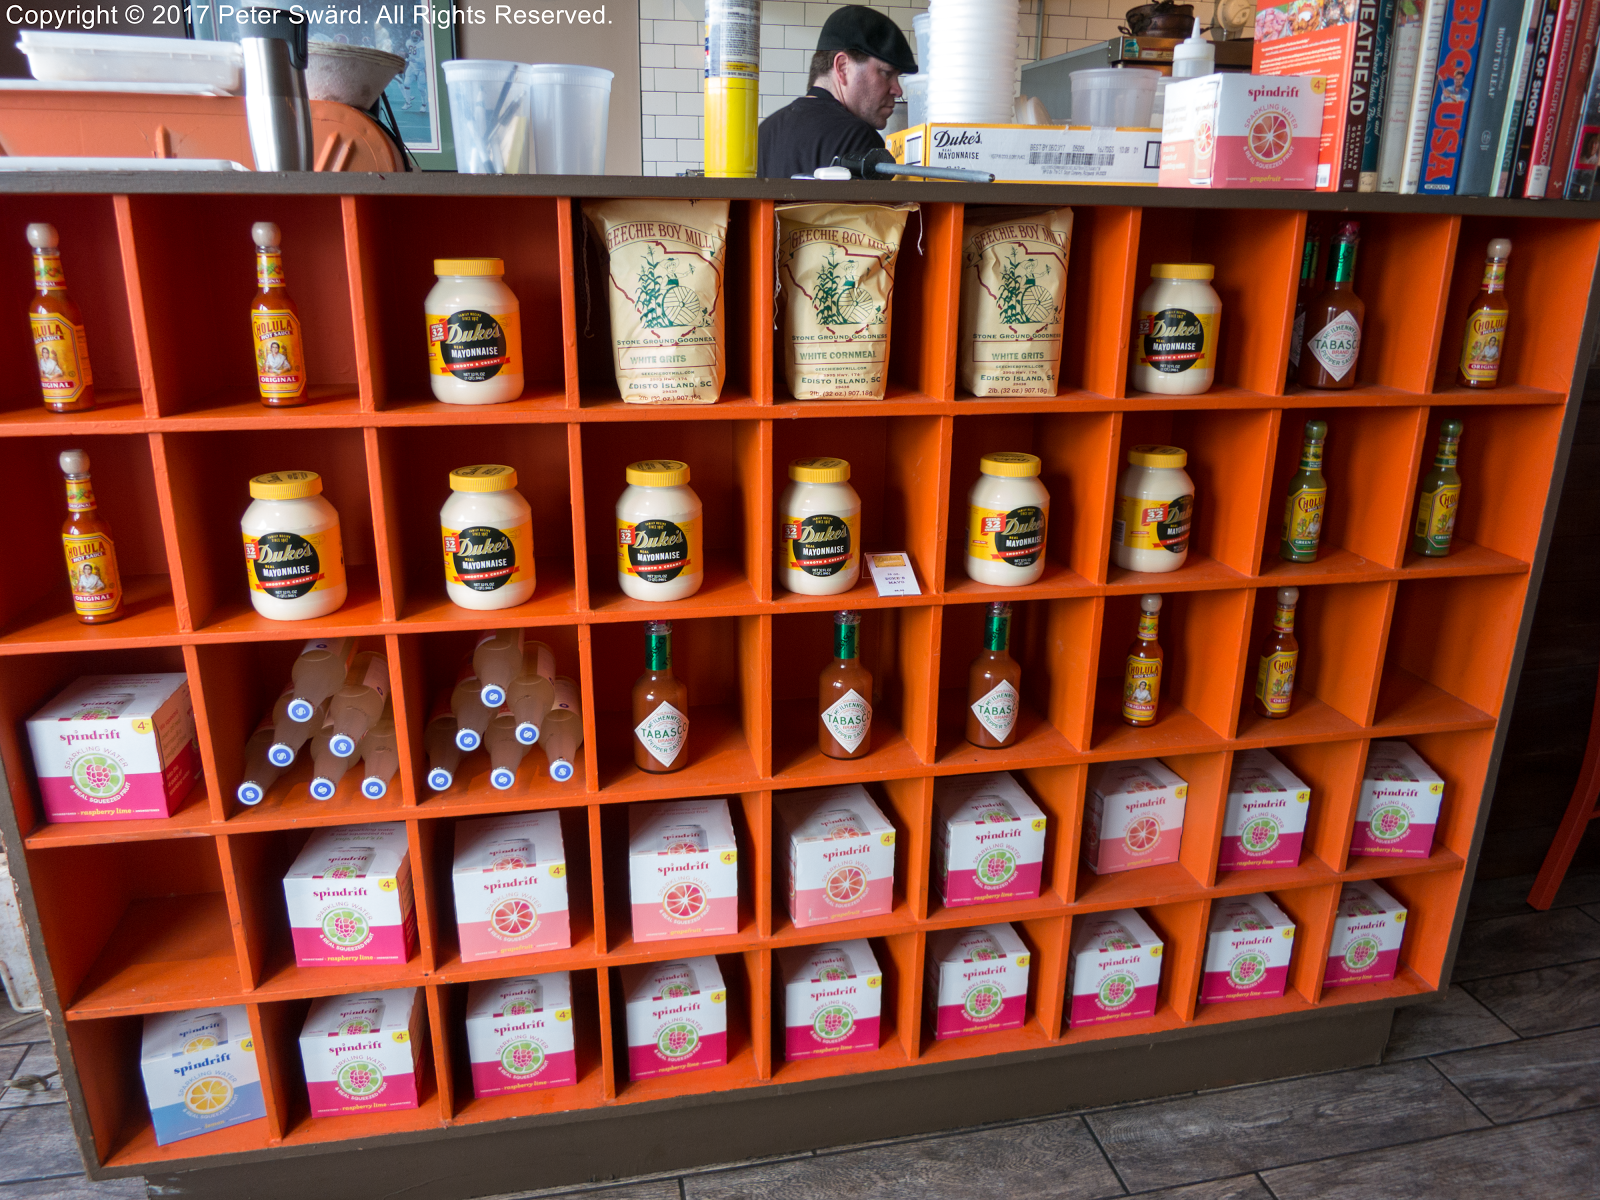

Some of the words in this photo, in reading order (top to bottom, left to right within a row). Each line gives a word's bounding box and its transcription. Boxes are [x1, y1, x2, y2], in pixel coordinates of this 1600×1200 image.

[1495, 27, 1506, 54] ROOT
[1539, 15, 1554, 54] BOOK
[1556, 24, 1573, 79] HEIRLOOM
[1579, 44, 1591, 73] Code
[1535, 57, 1546, 77] OF
[1248, 85, 1300, 102] spindrift
[1487, 74, 1498, 99] LEAF
[1526, 80, 1542, 127] SMOKE
[1549, 80, 1563, 114] RECIPE
[1243, 104, 1280, 130] SPARKLING
[1281, 106, 1299, 130] WATER
[934, 130, 982, 148] Duke's
[1425, 101, 1465, 182] USA
[1502, 105, 1521, 168] PICKLING
[938, 151, 980, 161] MAYONNAISE
[1347, 126, 1357, 170] GOLDWYN
[1243, 150, 1256, 165] REAL
[1255, 159, 1283, 170] SQUEEZED
[1283, 146, 1295, 162] FRUIT
[1250, 175, 1282, 184] grapefruit
[658, 224, 683, 241] BOY
[685, 229, 713, 250] MILL
[792, 228, 839, 250] GEECHIE
[842, 231, 866, 246] BOY
[974, 225, 1018, 250] GEECHIE
[1020, 224, 1040, 239] BOY
[432, 328, 444, 338] 32
[445, 322, 501, 344] Duke's
[1151, 318, 1201, 338] Duke's
[851, 333, 888, 341] GOODNESS
[451, 346, 499, 359] MAYONNAISE
[1153, 342, 1196, 351] MAYONNAISE
[630, 356, 657, 365] WHITE
[659, 354, 687, 364] GRITS
[800, 352, 828, 361] WHITE
[829, 350, 877, 360] CORNMEAL
[991, 352, 1019, 361] WHITE
[1021, 351, 1044, 360] GRITS
[1321, 349, 1340, 366] PEPPER
[261, 376, 297, 384] ORIGINAL
[700, 380, 713, 388] SC
[834, 377, 869, 385] ISLAND,
[1148, 510, 1164, 520] 32
[786, 527, 797, 536] 32
[985, 521, 1001, 529] 32
[621, 532, 632, 541] 32
[632, 529, 684, 549] Duke's
[798, 524, 847, 544] Duke's
[1005, 535, 1042, 548] MAYONNAISE
[246, 547, 256, 555] 32
[257, 542, 313, 564] Duke's
[456, 537, 510, 557] Duke's
[802, 545, 844, 556] MAYONNAISE
[462, 558, 508, 570] MAYONNAISE
[637, 551, 681, 562] MAYONNAISE
[262, 565, 311, 578] MAYONNAISE
[75, 593, 110, 602] ORIGINAL
[1125, 702, 1154, 711] ORIGINAL
[827, 710, 871, 725] TABASCO
[60, 729, 121, 746] spindrift
[640, 721, 687, 739] TABASCO
[834, 724, 852, 739] PEPPER
[647, 738, 668, 753] PEPPER
[64, 745, 101, 770] SPARKLING
[103, 747, 129, 768] WATER
[73, 788, 89, 801] REAL
[89, 794, 122, 804] SQUEEZED
[120, 781, 132, 797] FRUIT
[1372, 787, 1419, 799] spindrift
[80, 809, 115, 817] raspberry
[116, 807, 132, 815] lime
[1125, 796, 1166, 813] spindrift
[1242, 798, 1286, 812] spindrift
[975, 828, 1022, 844] spindrift
[822, 843, 871, 862] spindrift
[657, 860, 710, 877] spindrift
[483, 875, 539, 894] spindrift
[313, 887, 368, 901] spindrift
[315, 901, 350, 922] SPARKLING
[351, 902, 373, 921] WATER
[1347, 919, 1386, 934] spindrift
[323, 938, 335, 948] REAL
[335, 942, 366, 952] SQUEEZED
[364, 932, 375, 946] FRUIT
[1231, 936, 1273, 949] spindrift
[327, 954, 358, 963] raspberry
[359, 953, 374, 962] lime
[1098, 955, 1141, 970] spindrift
[963, 965, 1007, 981] spindrift
[811, 986, 857, 1002] spindrift
[652, 1002, 701, 1020] spindrift
[493, 1020, 546, 1037] spindrift
[328, 1041, 382, 1056] spindrift
[173, 1052, 231, 1077] spindrift
[178, 1070, 212, 1097] SPARKLING
[214, 1069, 238, 1084] WATER
[204, 1119, 225, 1129] lemon
